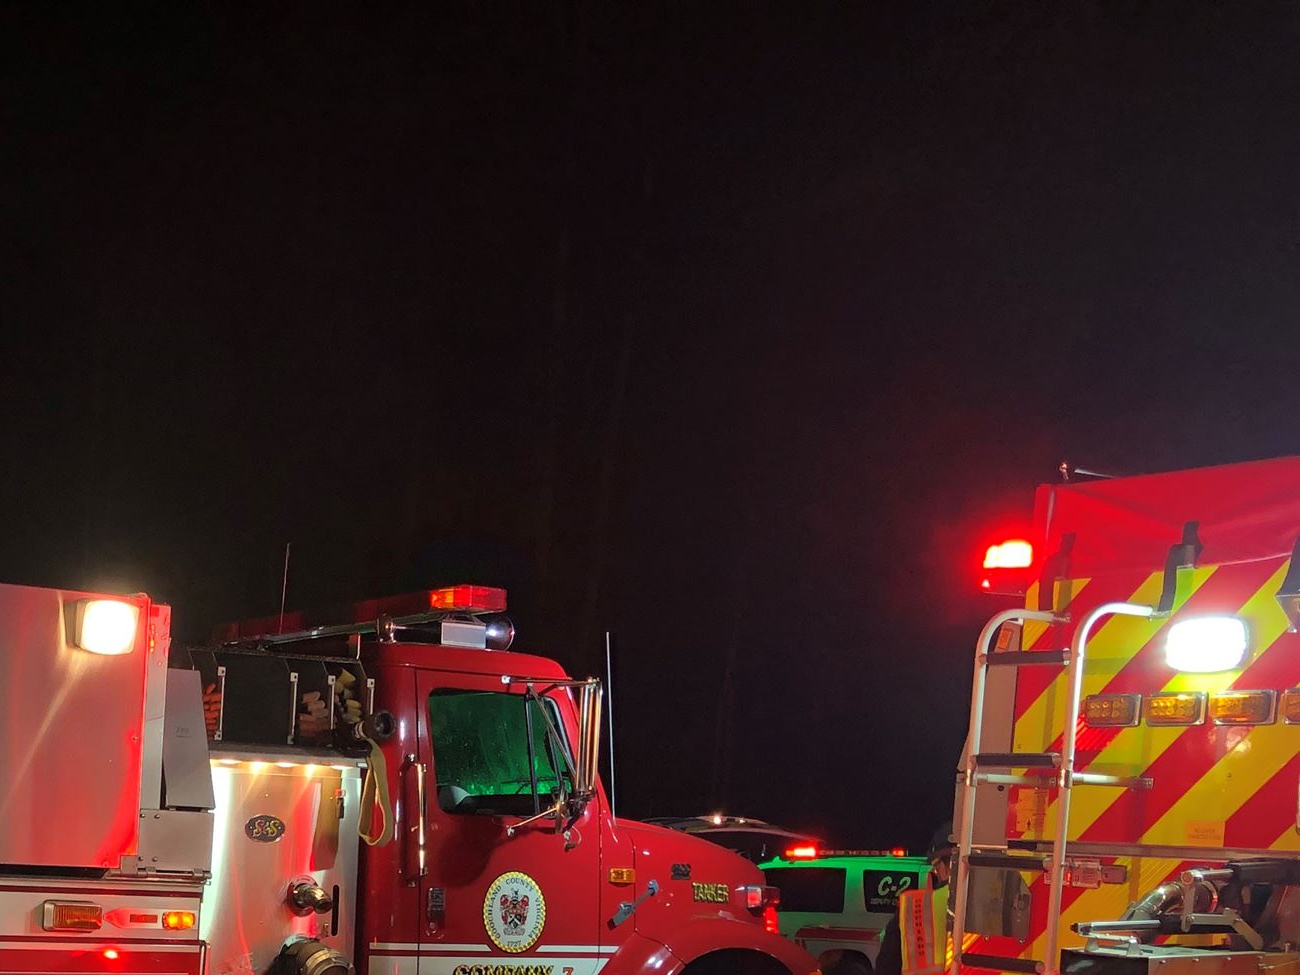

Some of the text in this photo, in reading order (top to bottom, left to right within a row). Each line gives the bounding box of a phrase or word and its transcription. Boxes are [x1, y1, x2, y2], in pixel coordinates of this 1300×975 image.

[505, 877, 534, 892] COUNTY
[528, 897, 541, 939] VIRGINIA
[692, 882, 729, 903] TANKER
